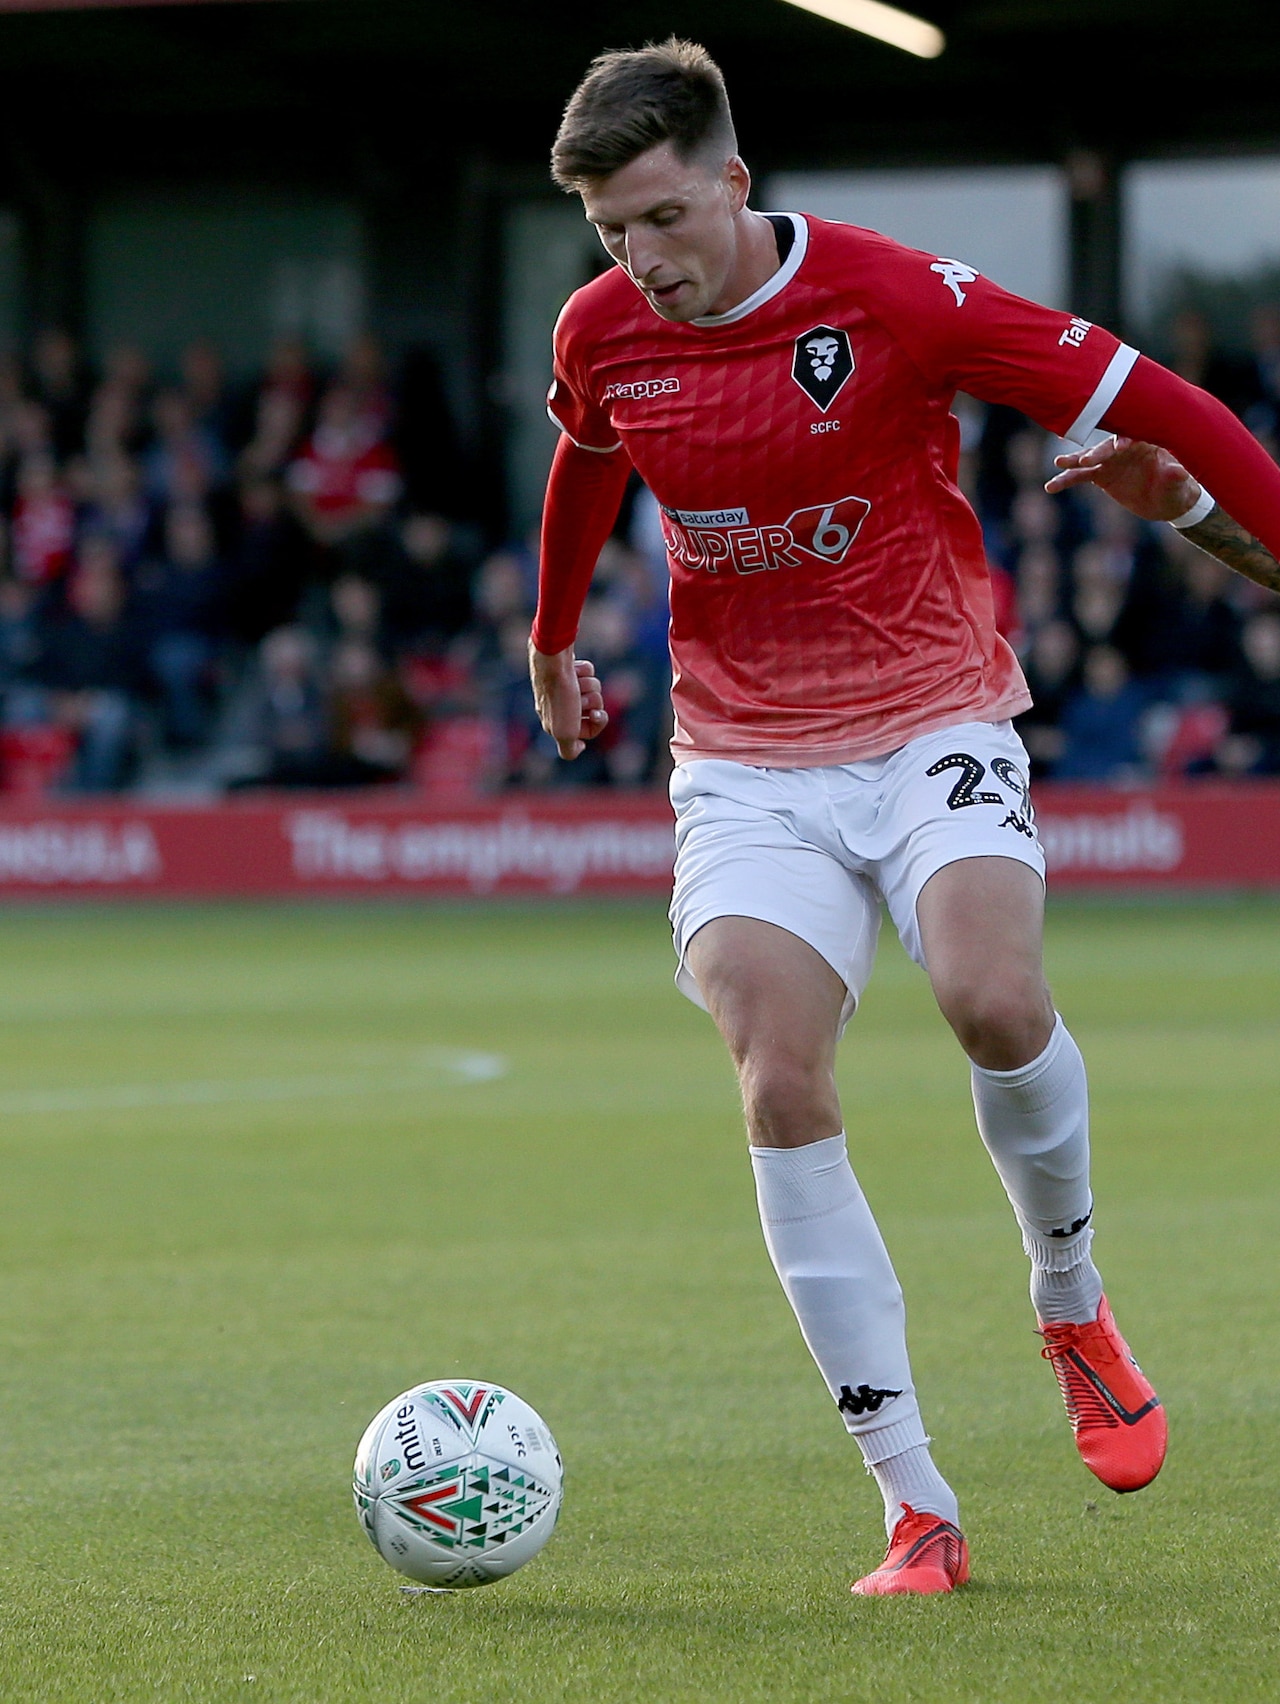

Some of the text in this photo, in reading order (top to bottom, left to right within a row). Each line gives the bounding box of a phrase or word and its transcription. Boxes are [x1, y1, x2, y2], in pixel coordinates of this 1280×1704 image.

[810, 420, 841, 435] SCFC
[680, 509, 744, 525] saturday
[394, 1404, 426, 1471] mitre
